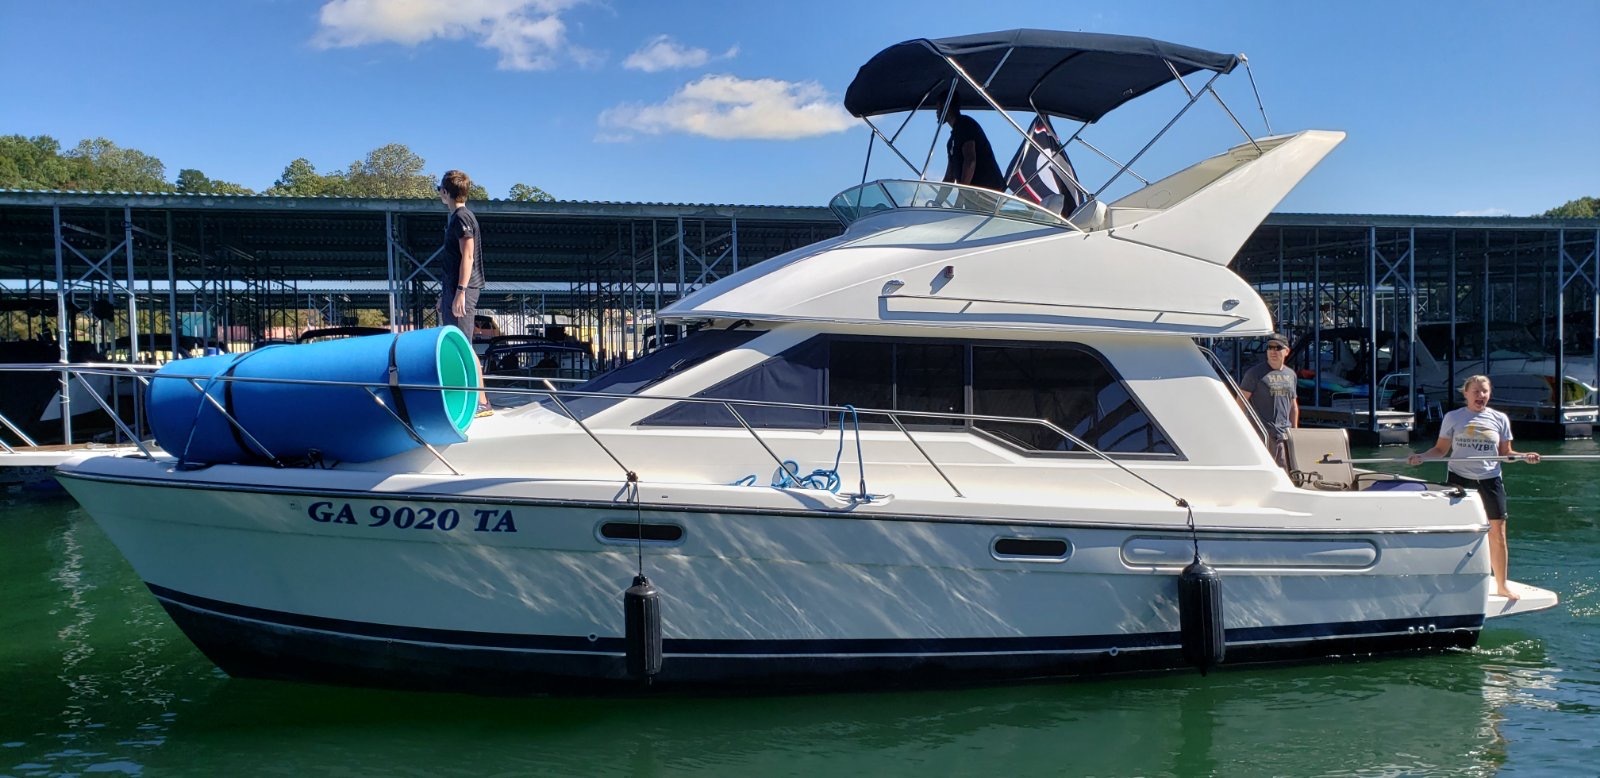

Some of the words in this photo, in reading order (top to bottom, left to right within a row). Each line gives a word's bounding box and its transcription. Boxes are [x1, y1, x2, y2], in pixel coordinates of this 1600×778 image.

[308, 501, 358, 525] GA
[368, 505, 460, 531] 9020
[474, 509, 517, 533] TA
